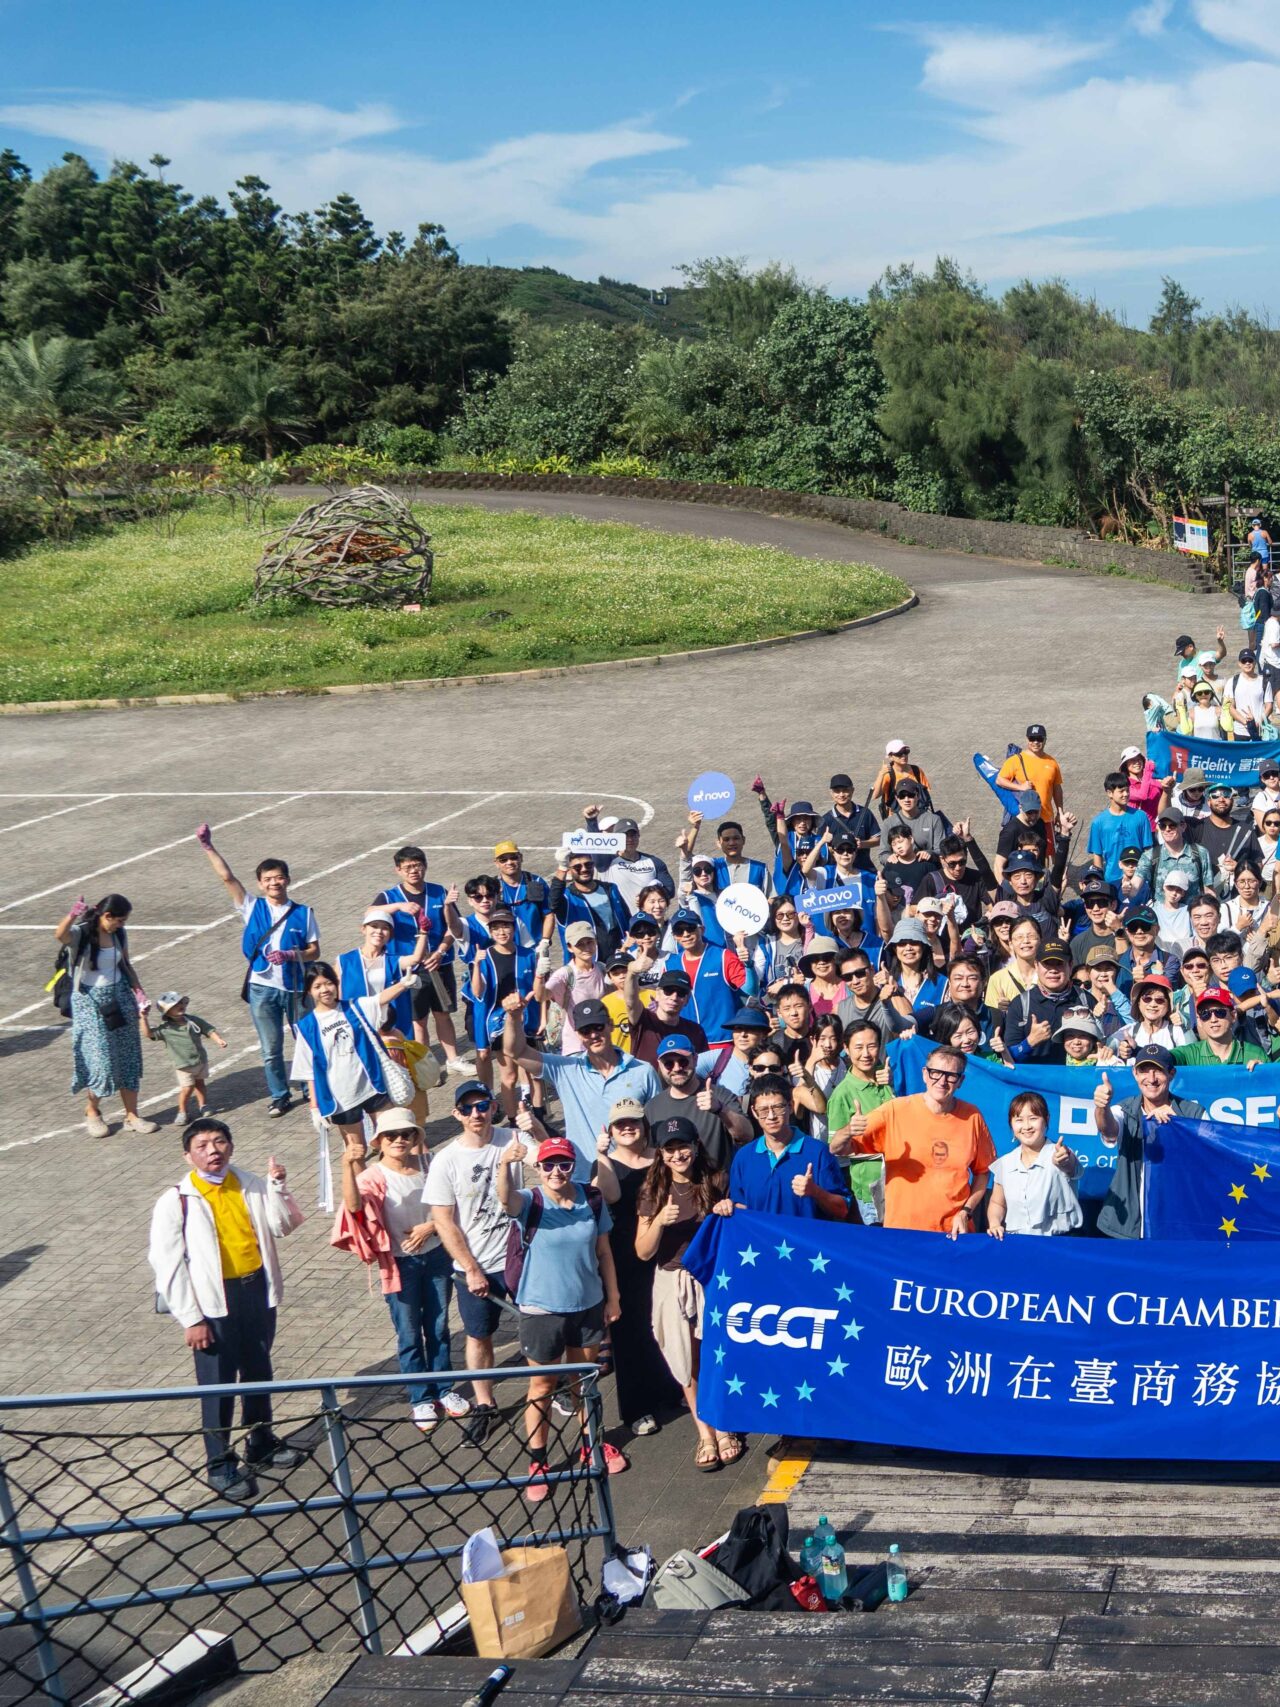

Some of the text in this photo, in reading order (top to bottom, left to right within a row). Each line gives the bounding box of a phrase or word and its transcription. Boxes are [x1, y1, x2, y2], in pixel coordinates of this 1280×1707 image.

[1191, 755, 1236, 774] Fidelity
[705, 791, 730, 800] novo
[586, 837, 618, 847] novo
[818, 890, 852, 905] novo
[735, 905, 761, 923] novo
[890, 1279, 1096, 1325] EUROPEAN
